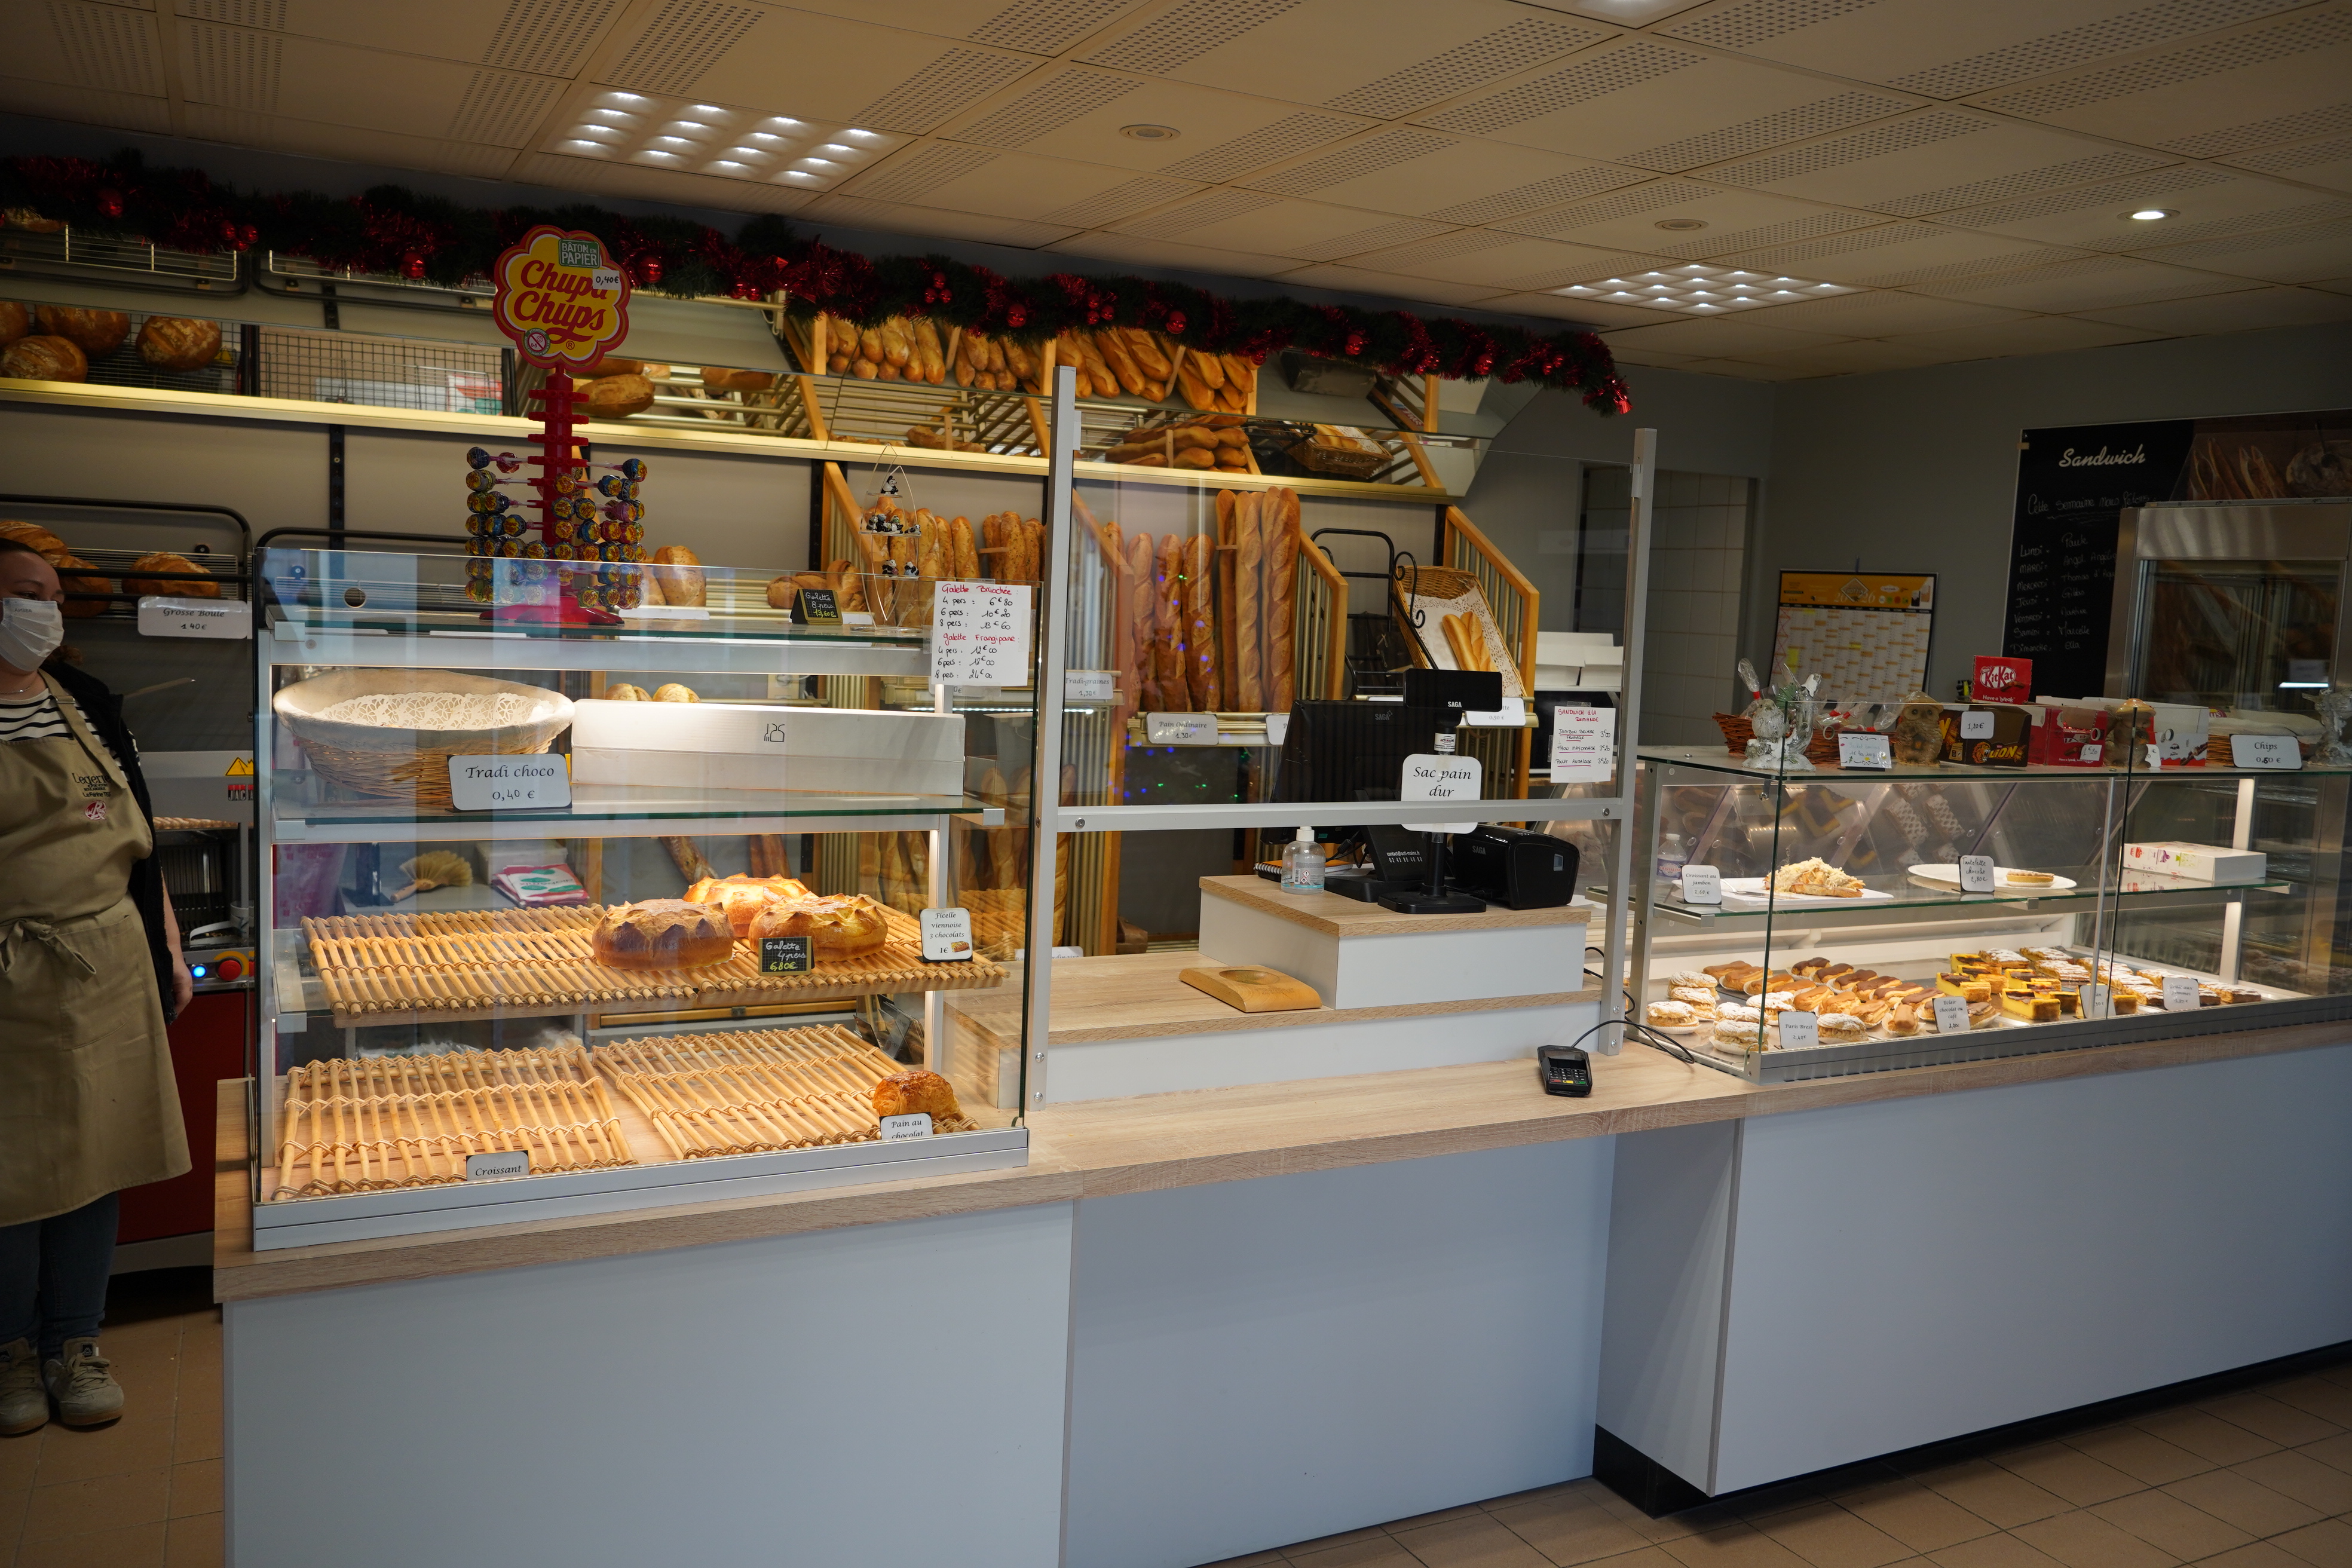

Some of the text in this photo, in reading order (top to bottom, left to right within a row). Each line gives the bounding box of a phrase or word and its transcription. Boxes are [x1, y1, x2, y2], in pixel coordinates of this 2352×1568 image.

[562, 242, 589, 253] BÂTON
[562, 252, 598, 265] PAPIER
[596, 276, 619, 286] 0,40€
[514, 290, 606, 333] Chups
[2058, 443, 2146, 467] Sandwich
[942, 583, 969, 593] Galette
[163, 608, 195, 617] Grosse
[949, 610, 963, 618] pers
[947, 621, 961, 630] pers
[975, 634, 1016, 645] Frangipane
[945, 648, 957, 657] pers
[935, 670, 940, 678] 8
[942, 672, 954, 681] pers
[1984, 666, 2014, 688] KitKat
[1065, 677, 1110, 686] Tradi-graines
[1967, 722, 1984, 732] 1,20€
[2254, 742, 2277, 752] Chips
[466, 764, 555, 778] Tradi choco
[1413, 767, 1472, 782] Sac pain
[1429, 785, 1454, 797] dur
[1472, 845, 1486, 855] SAGA
[765, 941, 800, 950] Galette
[770, 961, 798, 971] 6,80€
[891, 1120, 909, 1128] Pain
[892, 1130, 924, 1139] chocolat
[475, 1165, 522, 1176] Croissant
